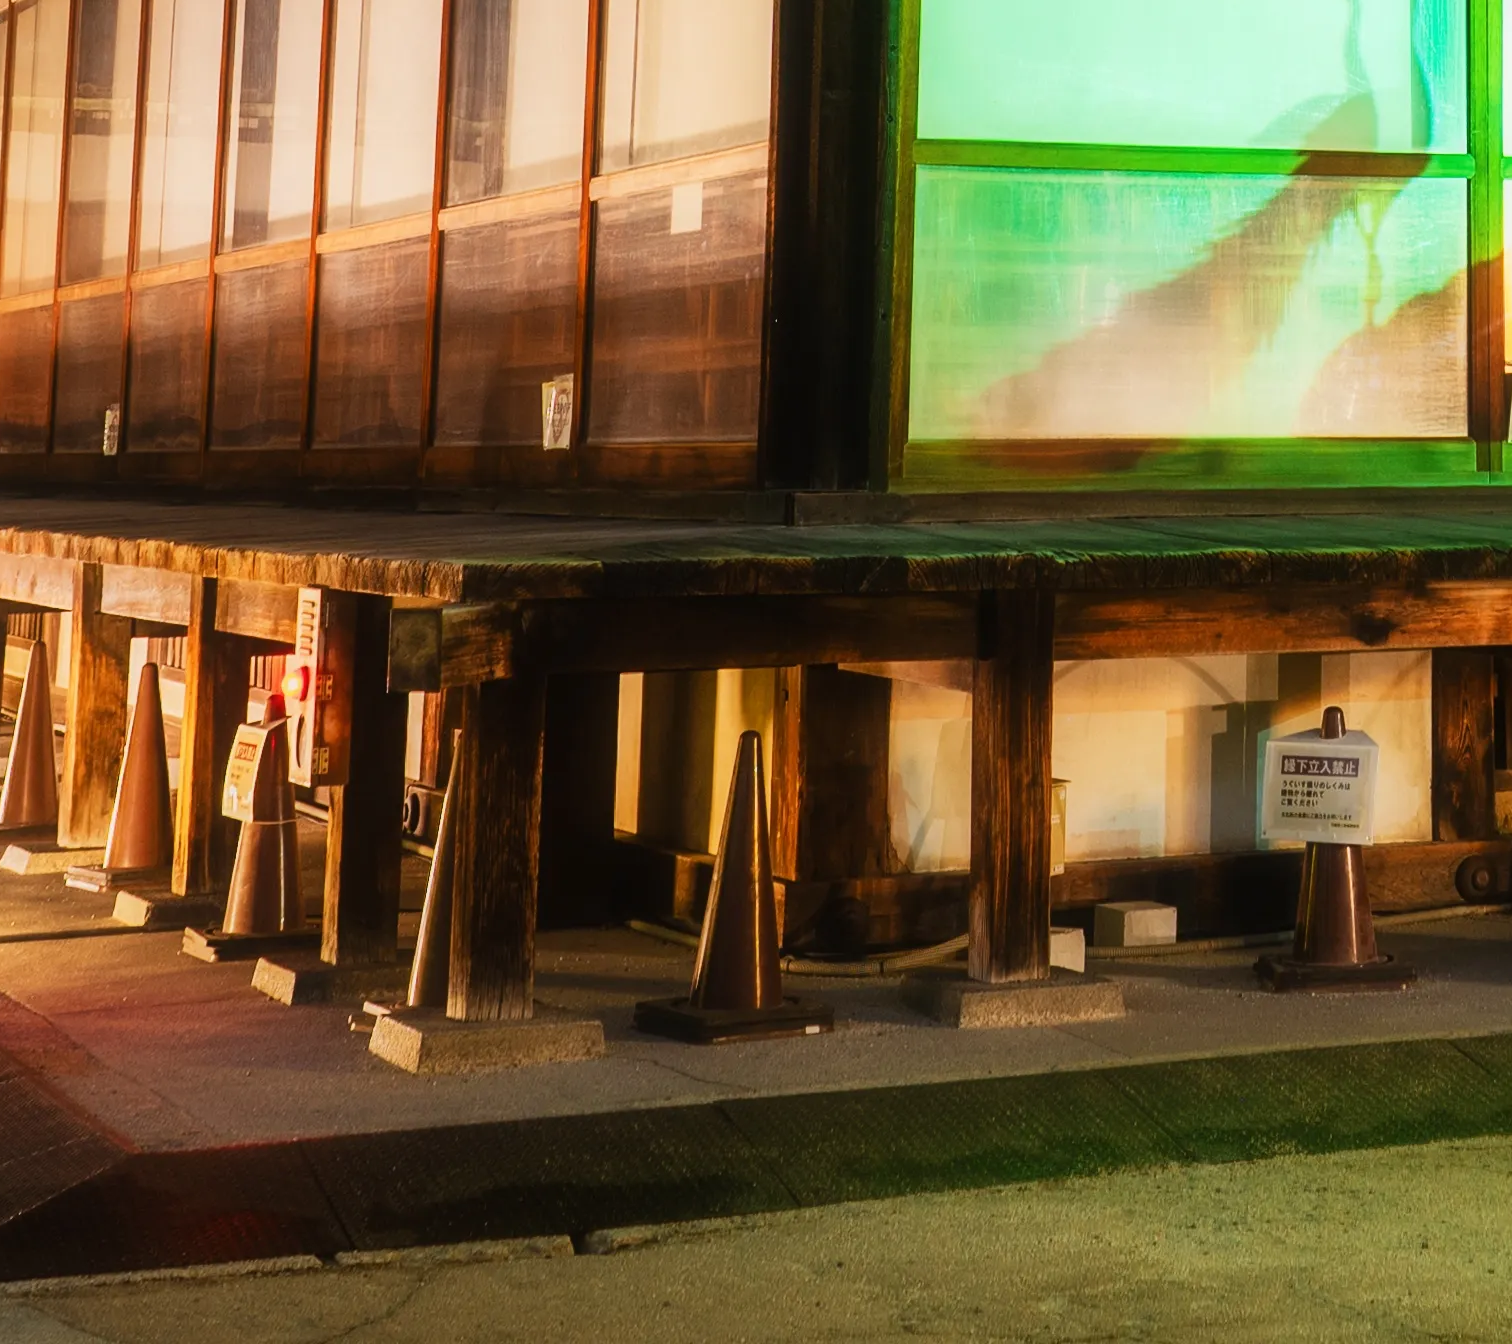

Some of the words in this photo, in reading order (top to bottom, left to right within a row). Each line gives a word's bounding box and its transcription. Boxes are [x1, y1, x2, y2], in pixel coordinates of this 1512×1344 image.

[1284, 758, 1356, 775] 縁下立入禁止
